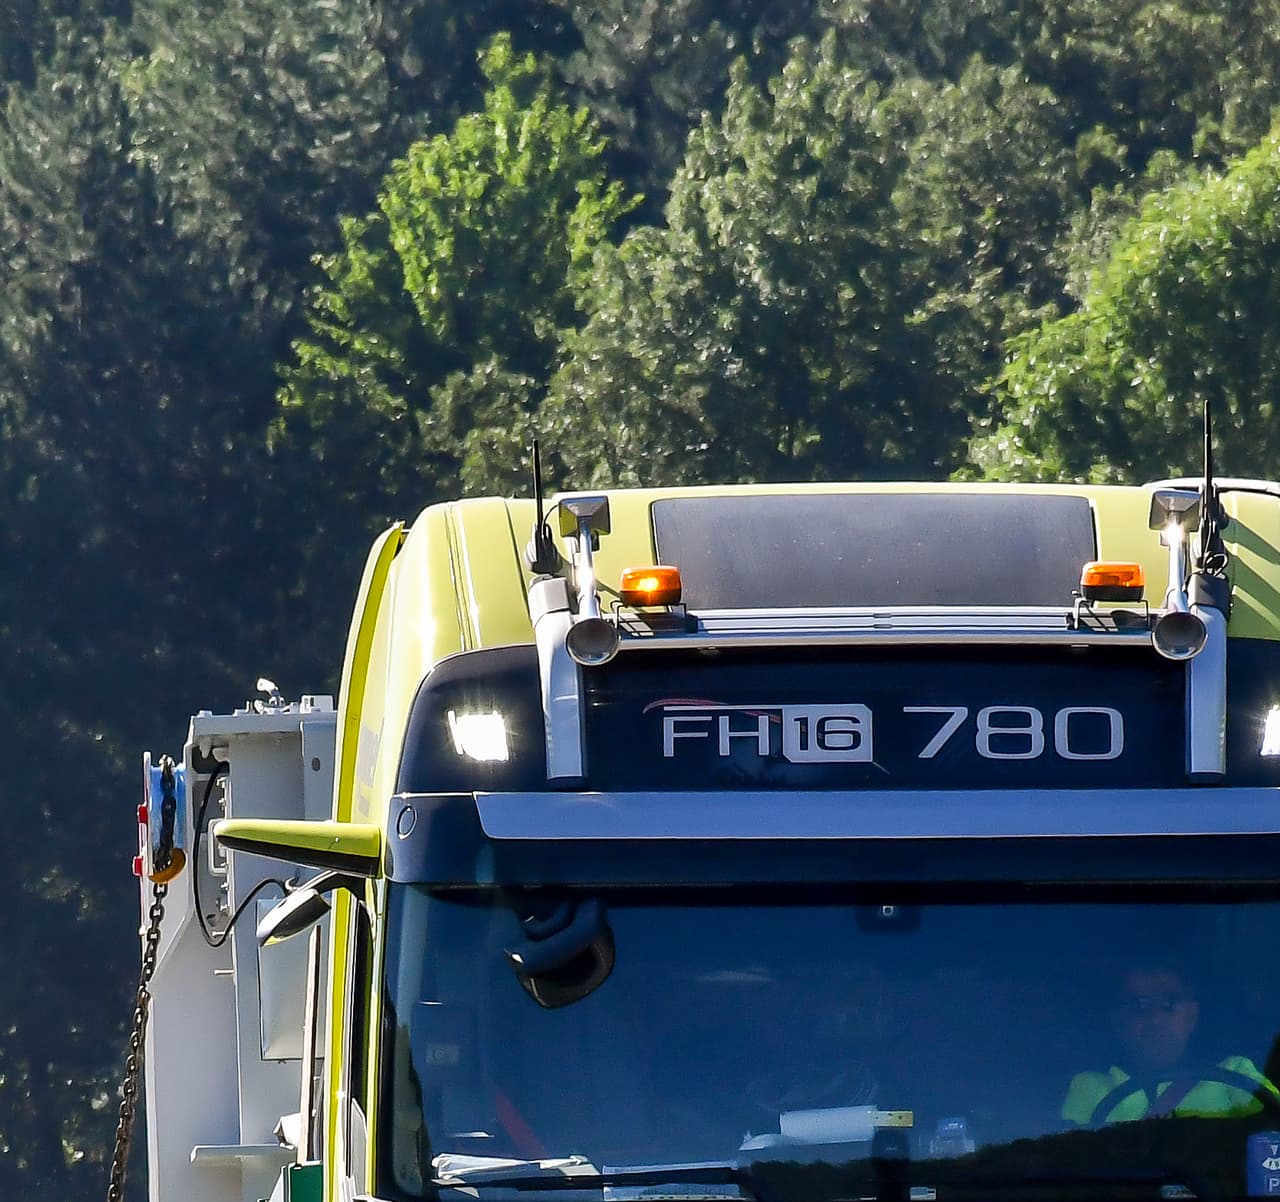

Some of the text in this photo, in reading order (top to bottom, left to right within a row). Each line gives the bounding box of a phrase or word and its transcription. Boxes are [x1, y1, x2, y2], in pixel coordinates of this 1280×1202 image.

[663, 705, 1124, 762] FH16 780
[1268, 1177, 1280, 1193] P
